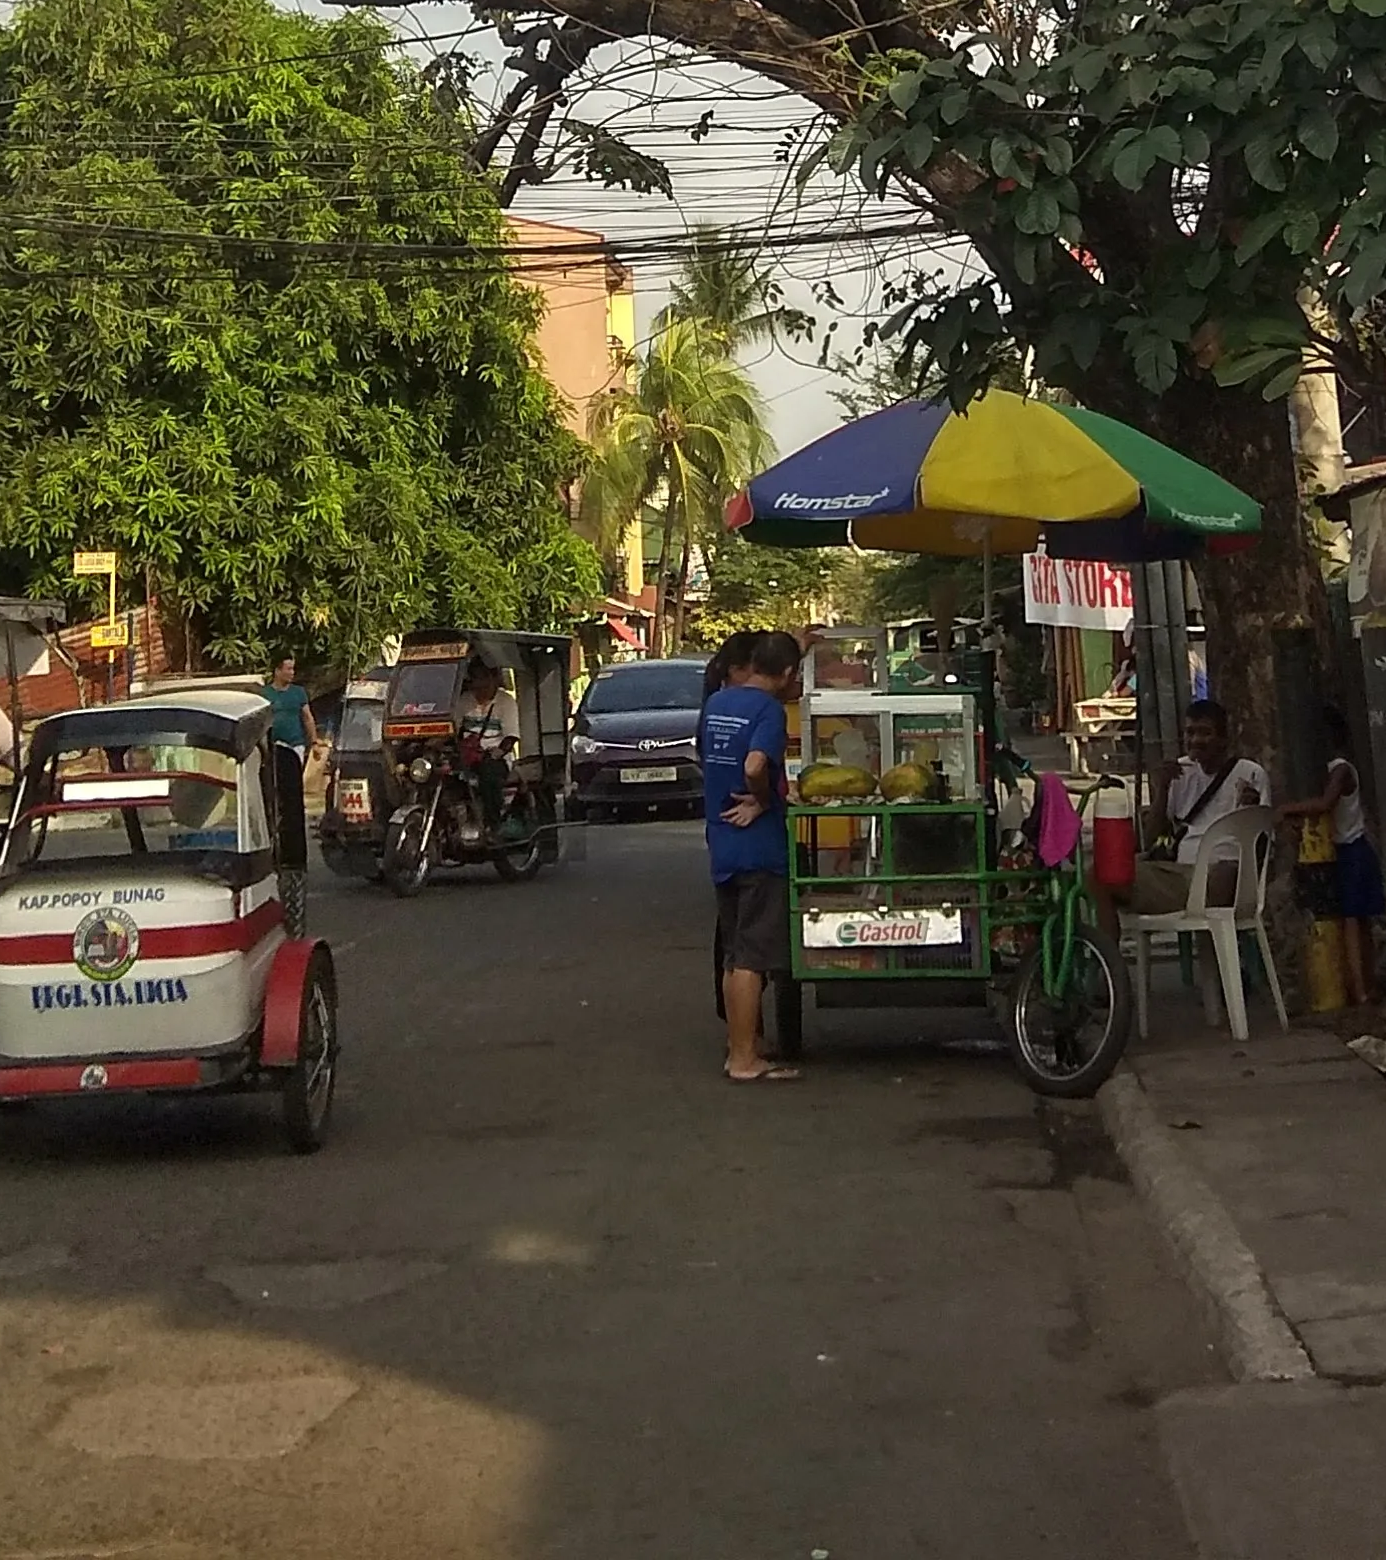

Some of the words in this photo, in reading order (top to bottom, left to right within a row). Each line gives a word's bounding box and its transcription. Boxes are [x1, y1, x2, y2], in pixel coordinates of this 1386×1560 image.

[774, 492, 879, 510] Homstar
[1063, 558, 1134, 609] STORE
[112, 887, 166, 905] BUNAG
[859, 921, 923, 943] Castrol
